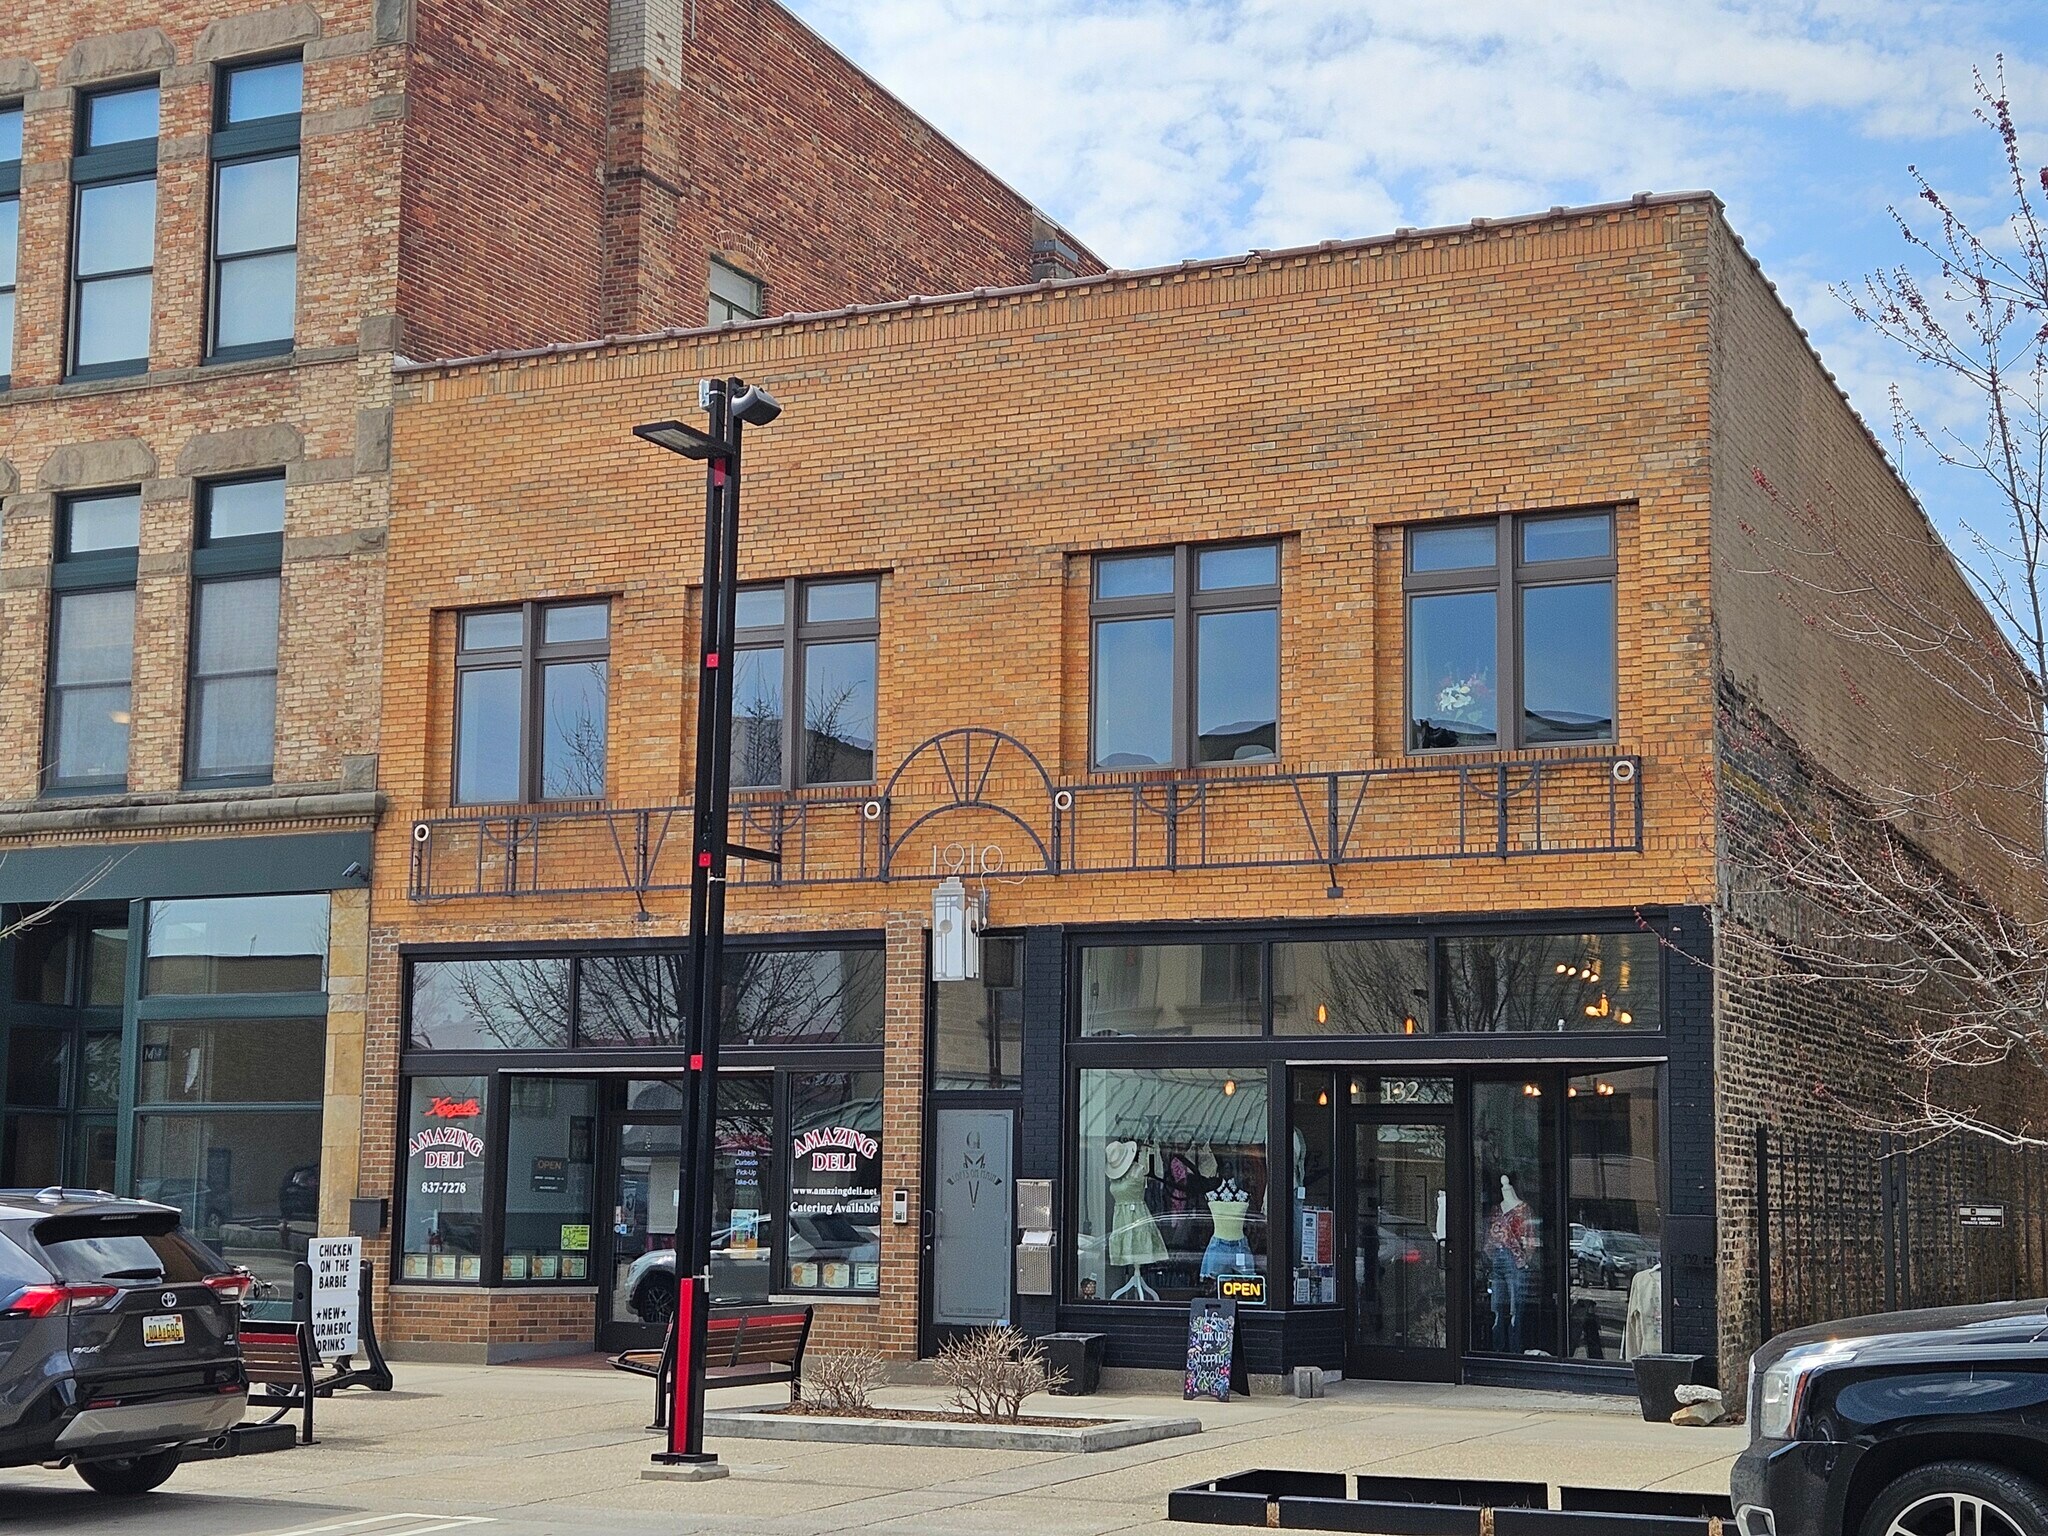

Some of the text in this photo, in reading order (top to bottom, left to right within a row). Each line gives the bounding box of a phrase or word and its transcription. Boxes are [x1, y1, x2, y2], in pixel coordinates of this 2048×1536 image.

[932, 843, 1003, 875] 1910
[1384, 1081, 1419, 1101] 132
[409, 1127, 484, 1157] AMAZING
[794, 1127, 878, 1159] AMAZING
[424, 1151, 465, 1168] DELI
[538, 1161, 562, 1169] OPEN
[812, 1153, 857, 1171] DELI
[736, 1169, 757, 1177] Pick-Up
[421, 1182, 467, 1194] 837-7278
[792, 1186, 877, 1197] www.amazingdeli.net
[790, 1201, 879, 1215] Catering Available
[319, 1244, 352, 1257] CHICKEN
[320, 1259, 349, 1273] ON THE
[319, 1275, 347, 1289] BARBIE
[1223, 1282, 1261, 1296] OPEN
[322, 1308, 340, 1320] NEW
[316, 1338, 345, 1352] DRINKS
